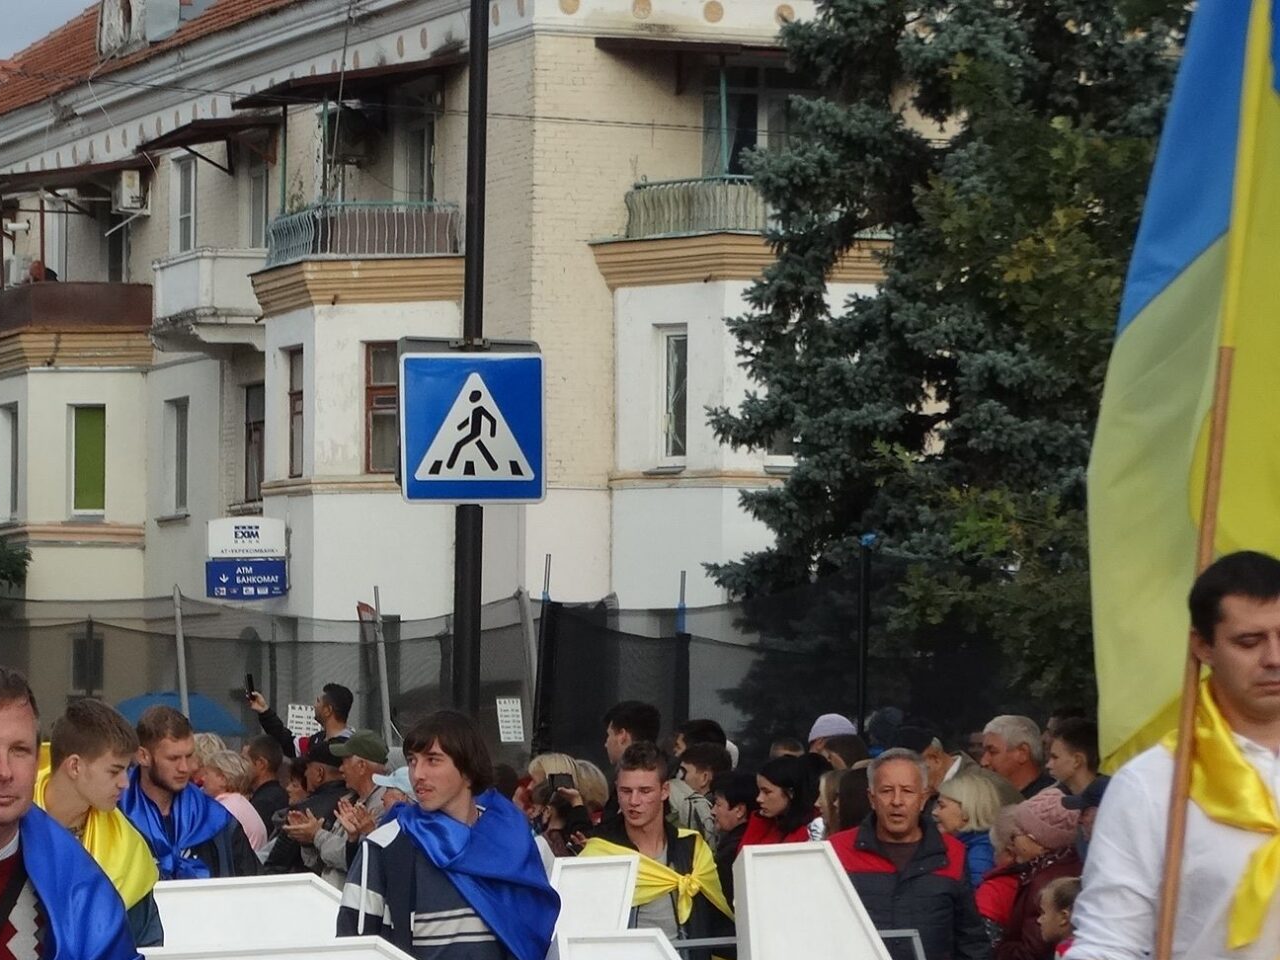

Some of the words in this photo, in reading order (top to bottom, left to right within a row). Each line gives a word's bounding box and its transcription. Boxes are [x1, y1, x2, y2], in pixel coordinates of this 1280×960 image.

[234, 530, 260, 539] EXIM
[236, 566, 253, 575] ATM
[235, 575, 280, 585] БАНКОМАТ
